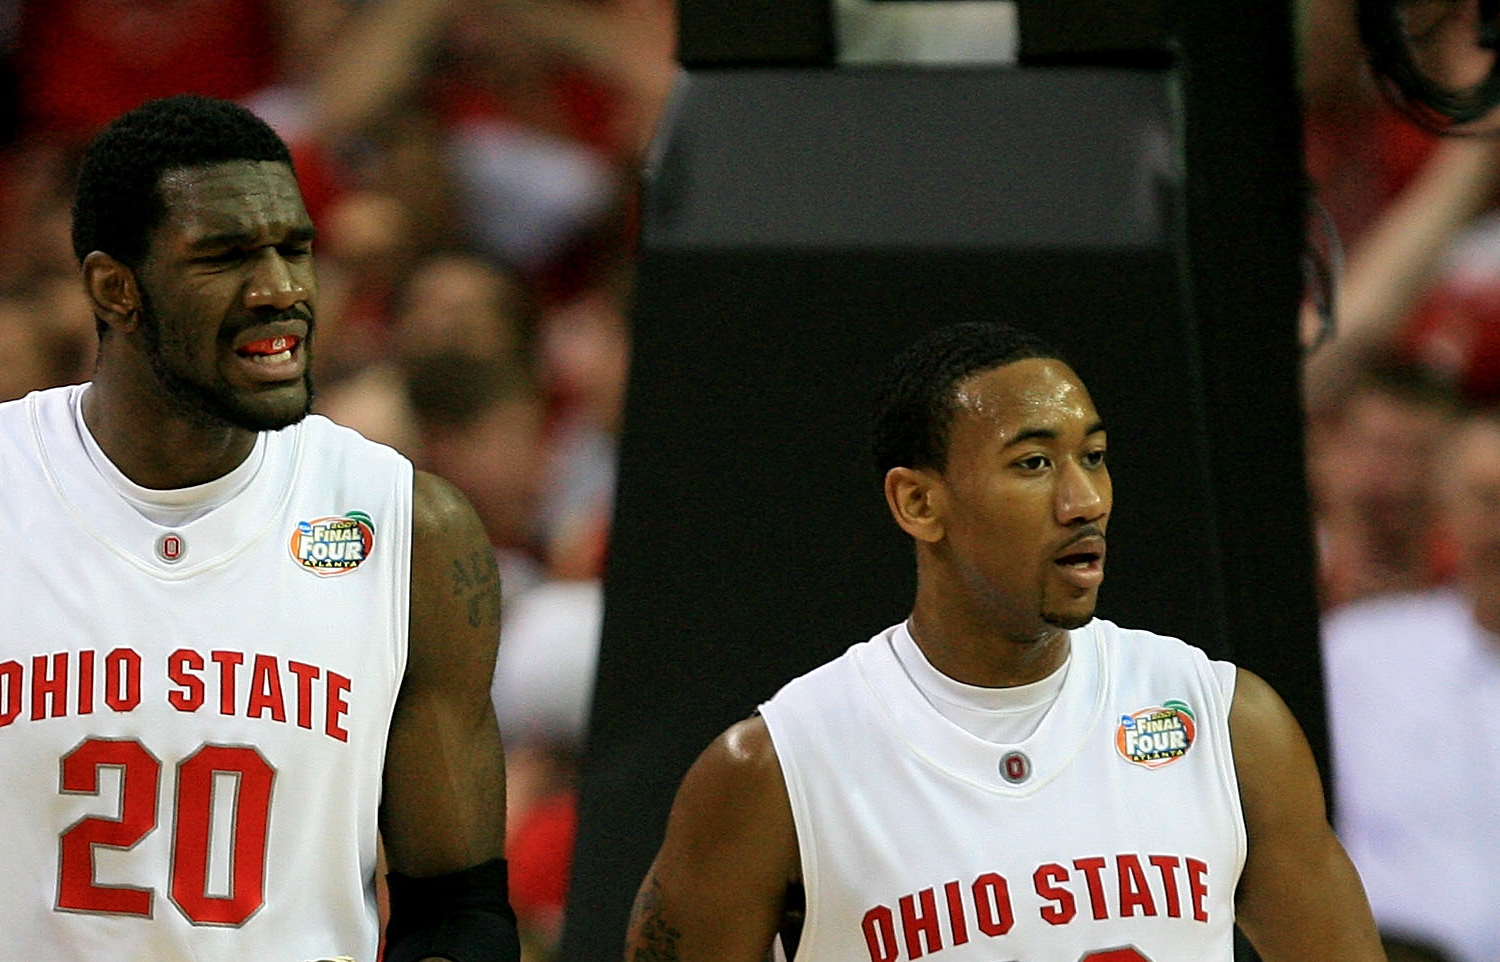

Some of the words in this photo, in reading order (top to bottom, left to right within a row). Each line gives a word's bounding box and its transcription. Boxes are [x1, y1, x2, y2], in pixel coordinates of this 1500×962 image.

[313, 525, 361, 542] FINAL
[298, 534, 364, 560] FOUR
[169, 647, 351, 742] STATE
[1136, 716, 1181, 735] FINAL
[1125, 729, 1187, 755] FOUR
[54, 736, 278, 927] 20
[1033, 853, 1209, 926] STATE
